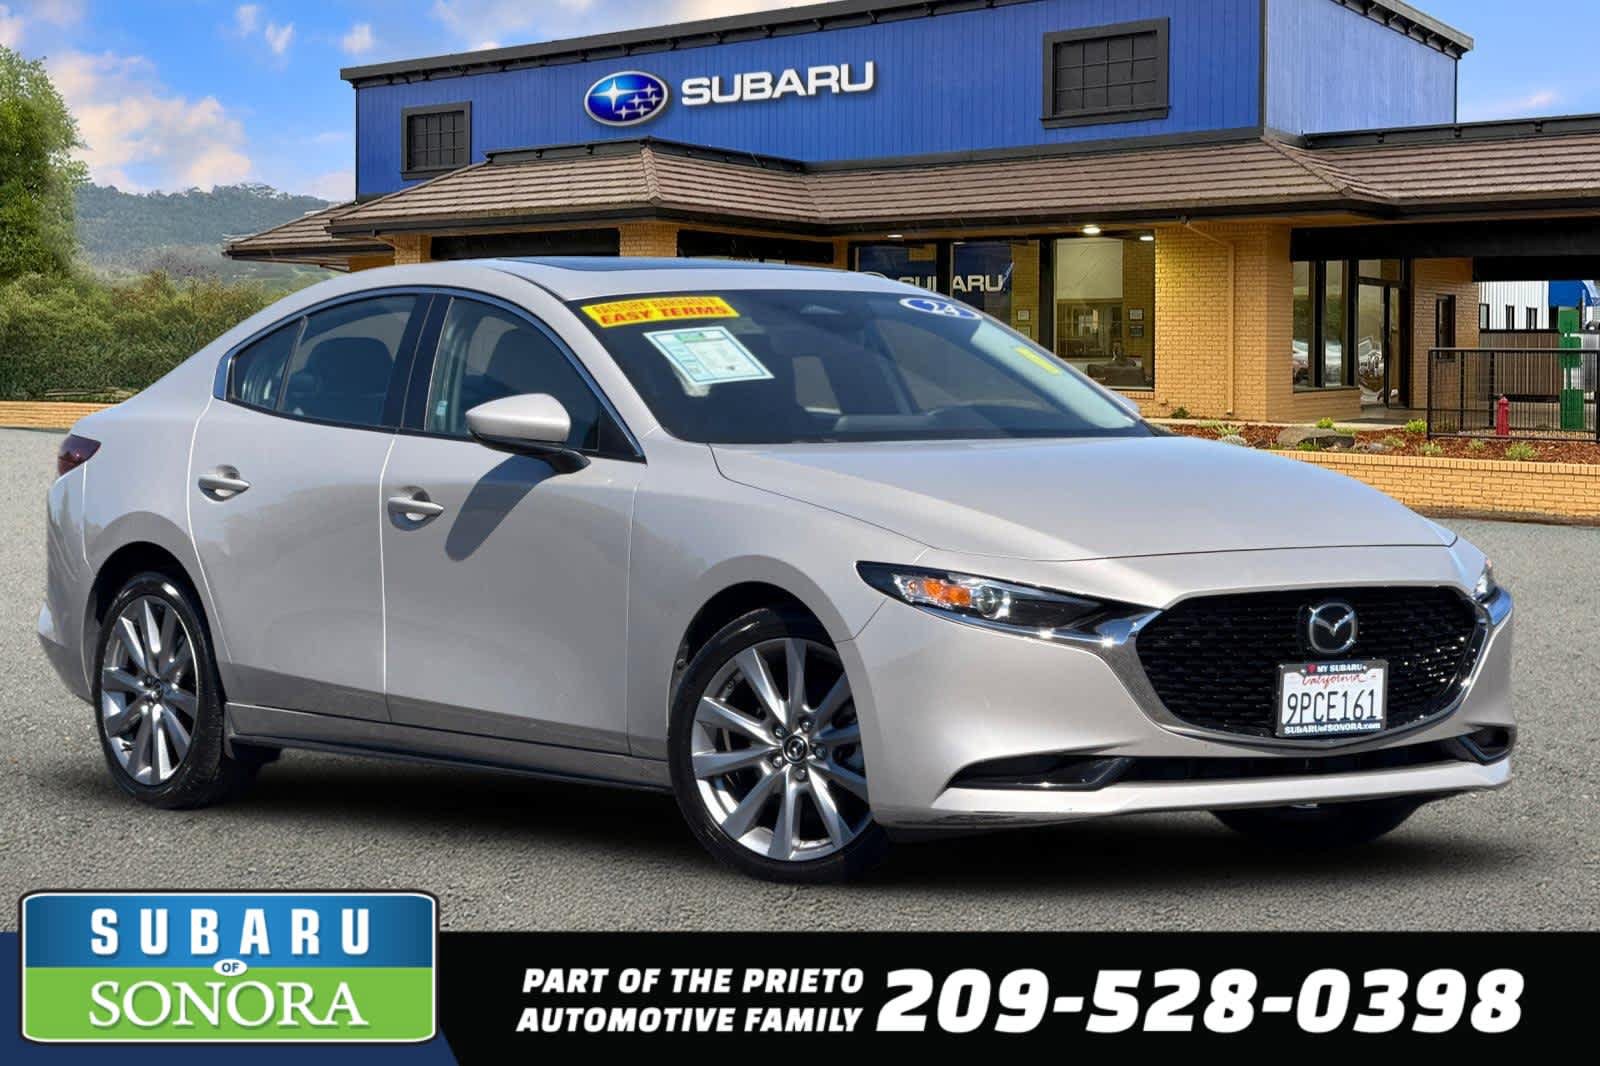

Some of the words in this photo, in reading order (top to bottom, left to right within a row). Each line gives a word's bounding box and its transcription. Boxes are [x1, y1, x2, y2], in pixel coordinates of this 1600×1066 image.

[681, 61, 875, 106] SUBARU
[899, 275, 1003, 292] SUARU
[600, 309, 651, 325] EASY
[659, 305, 729, 317] TERMS
[1317, 665, 1328, 673] MY
[1329, 663, 1363, 672] SUBARU
[1302, 674, 1367, 689] California
[1286, 688, 1377, 724] 9PCE161
